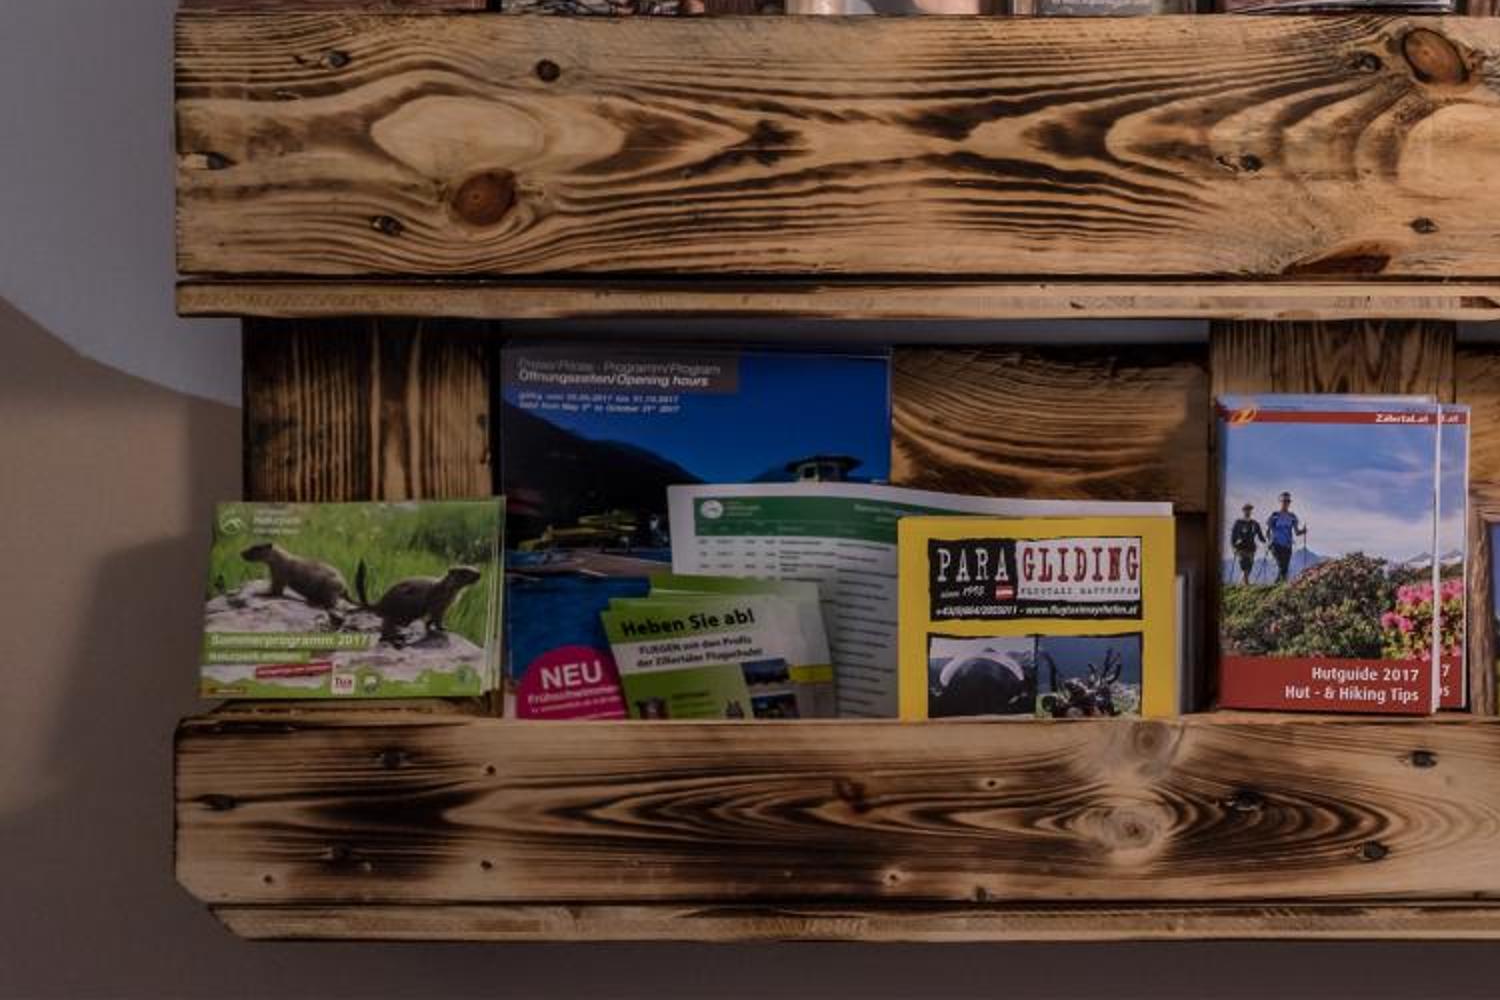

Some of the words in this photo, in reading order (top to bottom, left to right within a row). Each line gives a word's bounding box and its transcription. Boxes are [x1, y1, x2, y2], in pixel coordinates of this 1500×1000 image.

[937, 547, 1009, 582] PARA
[1023, 546, 1139, 583] GLIDING
[620, 618, 685, 637] Heben
[688, 613, 719, 630] Sie
[541, 660, 602, 689] NEU
[1311, 666, 1378, 683] Hutguide
[1383, 668, 1419, 681] 2017
[1285, 685, 1310, 699] Hut
[1324, 687, 1336, 699] &
[1339, 687, 1387, 704] Hiking
[1391, 688, 1419, 704] Tips
